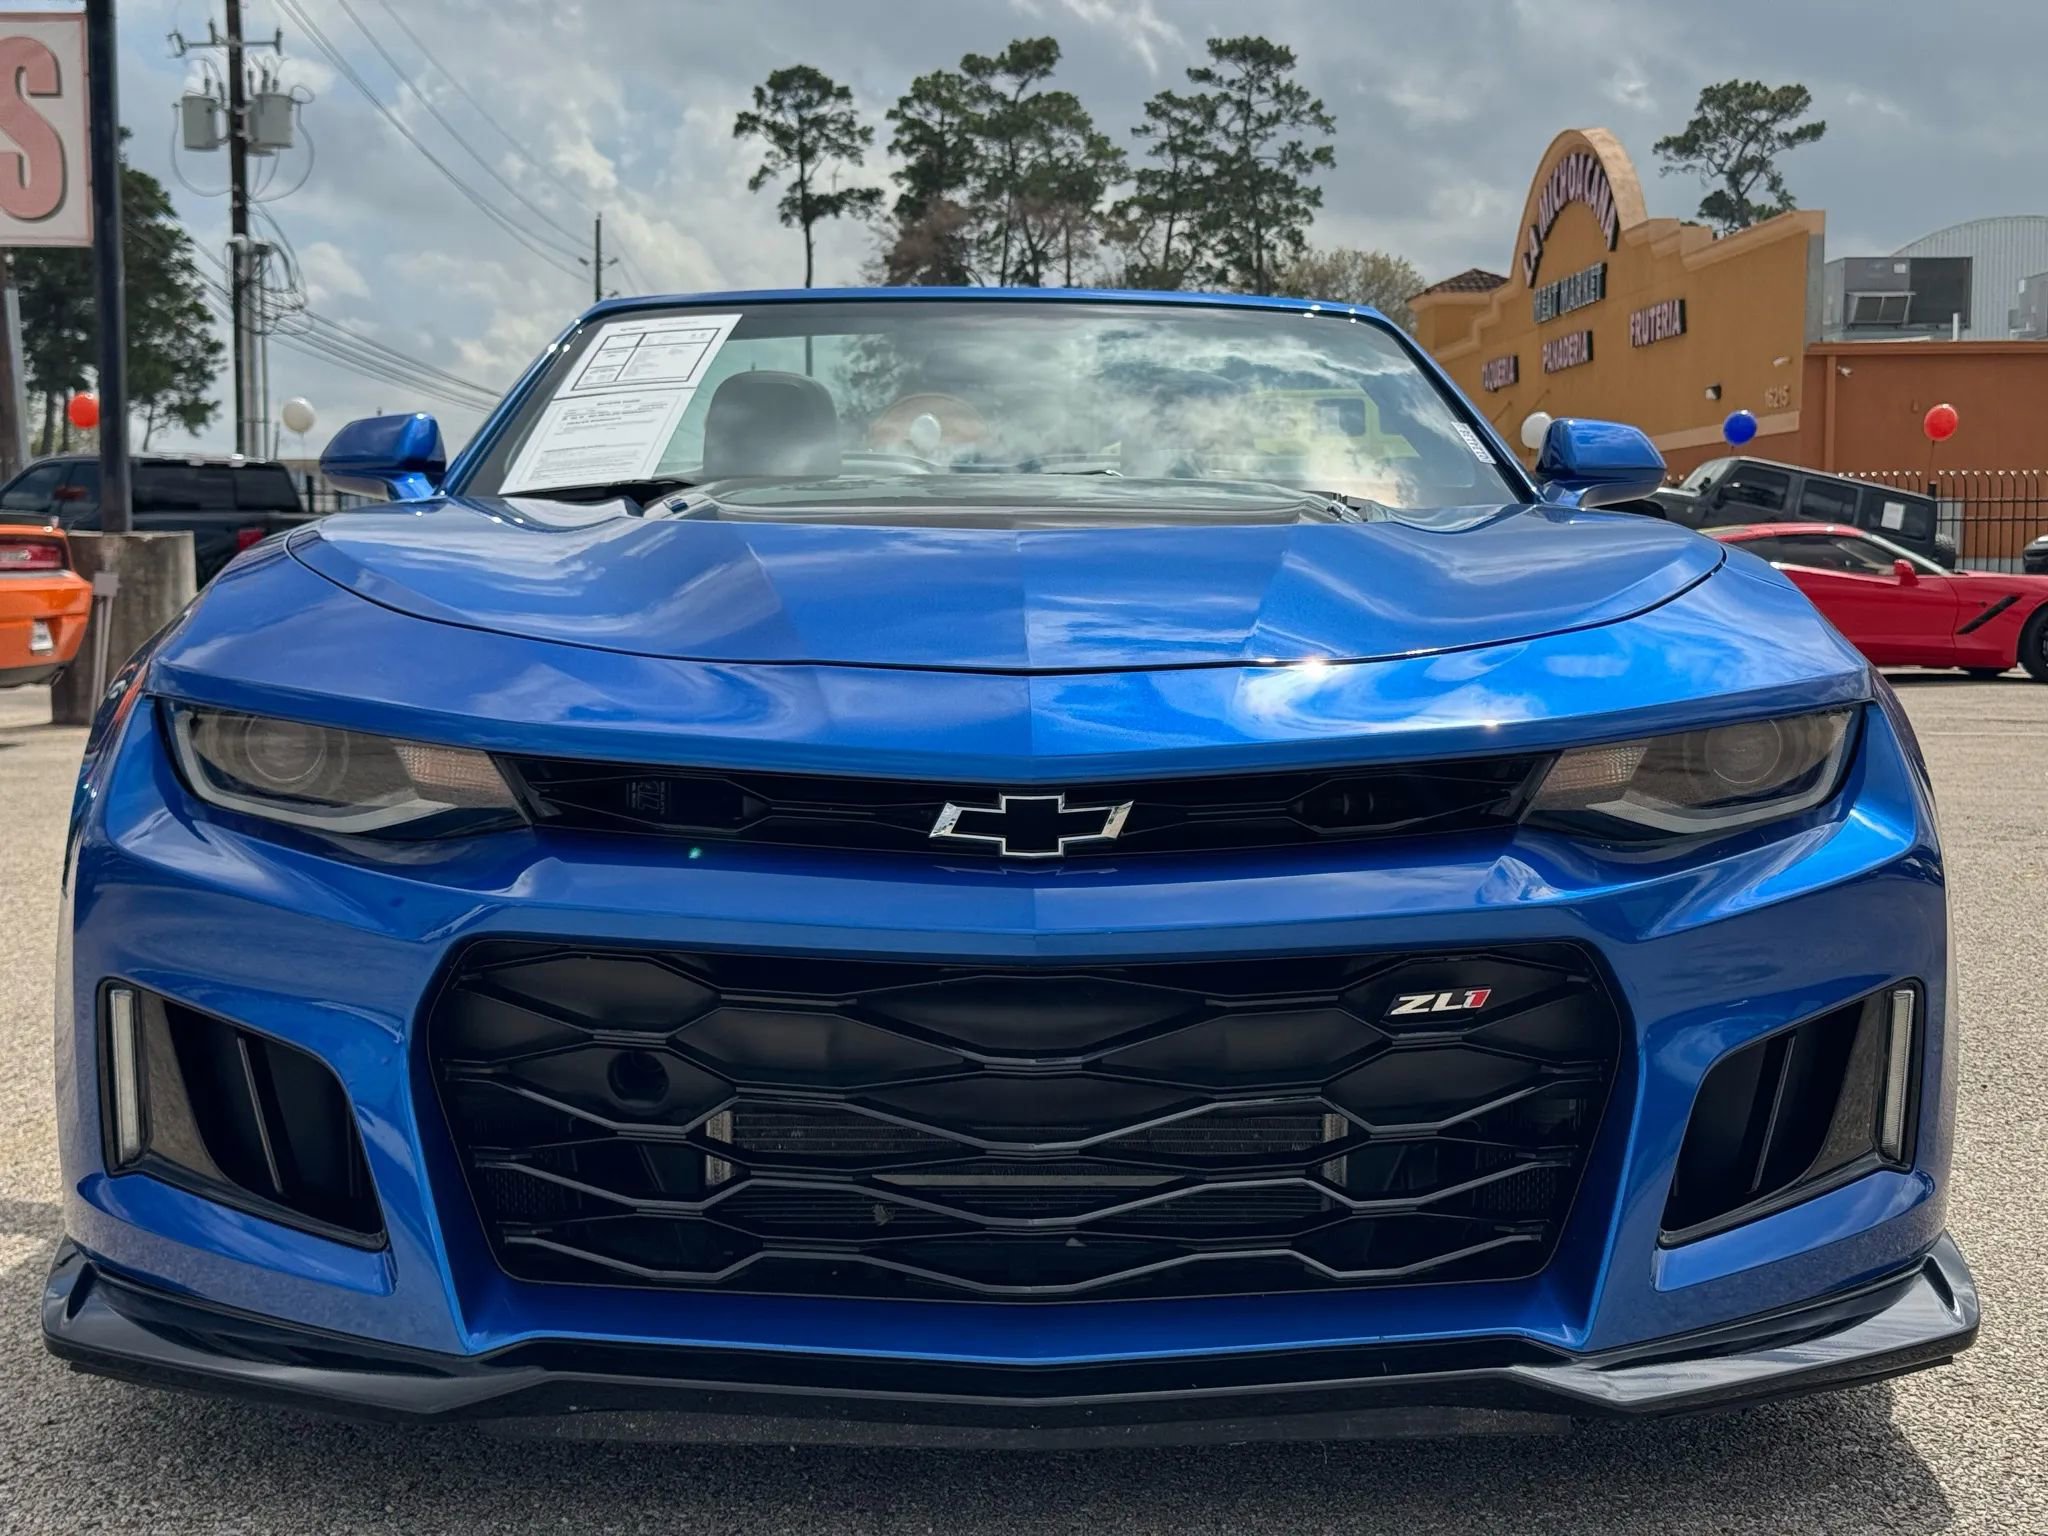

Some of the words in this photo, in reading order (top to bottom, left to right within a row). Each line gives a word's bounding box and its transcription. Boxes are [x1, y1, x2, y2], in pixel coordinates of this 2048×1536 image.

[1523, 225, 1542, 288] LA
[1538, 152, 1618, 251] MICHOACANA
[1630, 299, 1685, 348] FRUTERIA
[1542, 331, 1591, 374] PANADERIA
[1390, 988, 1492, 1016] ZL1
